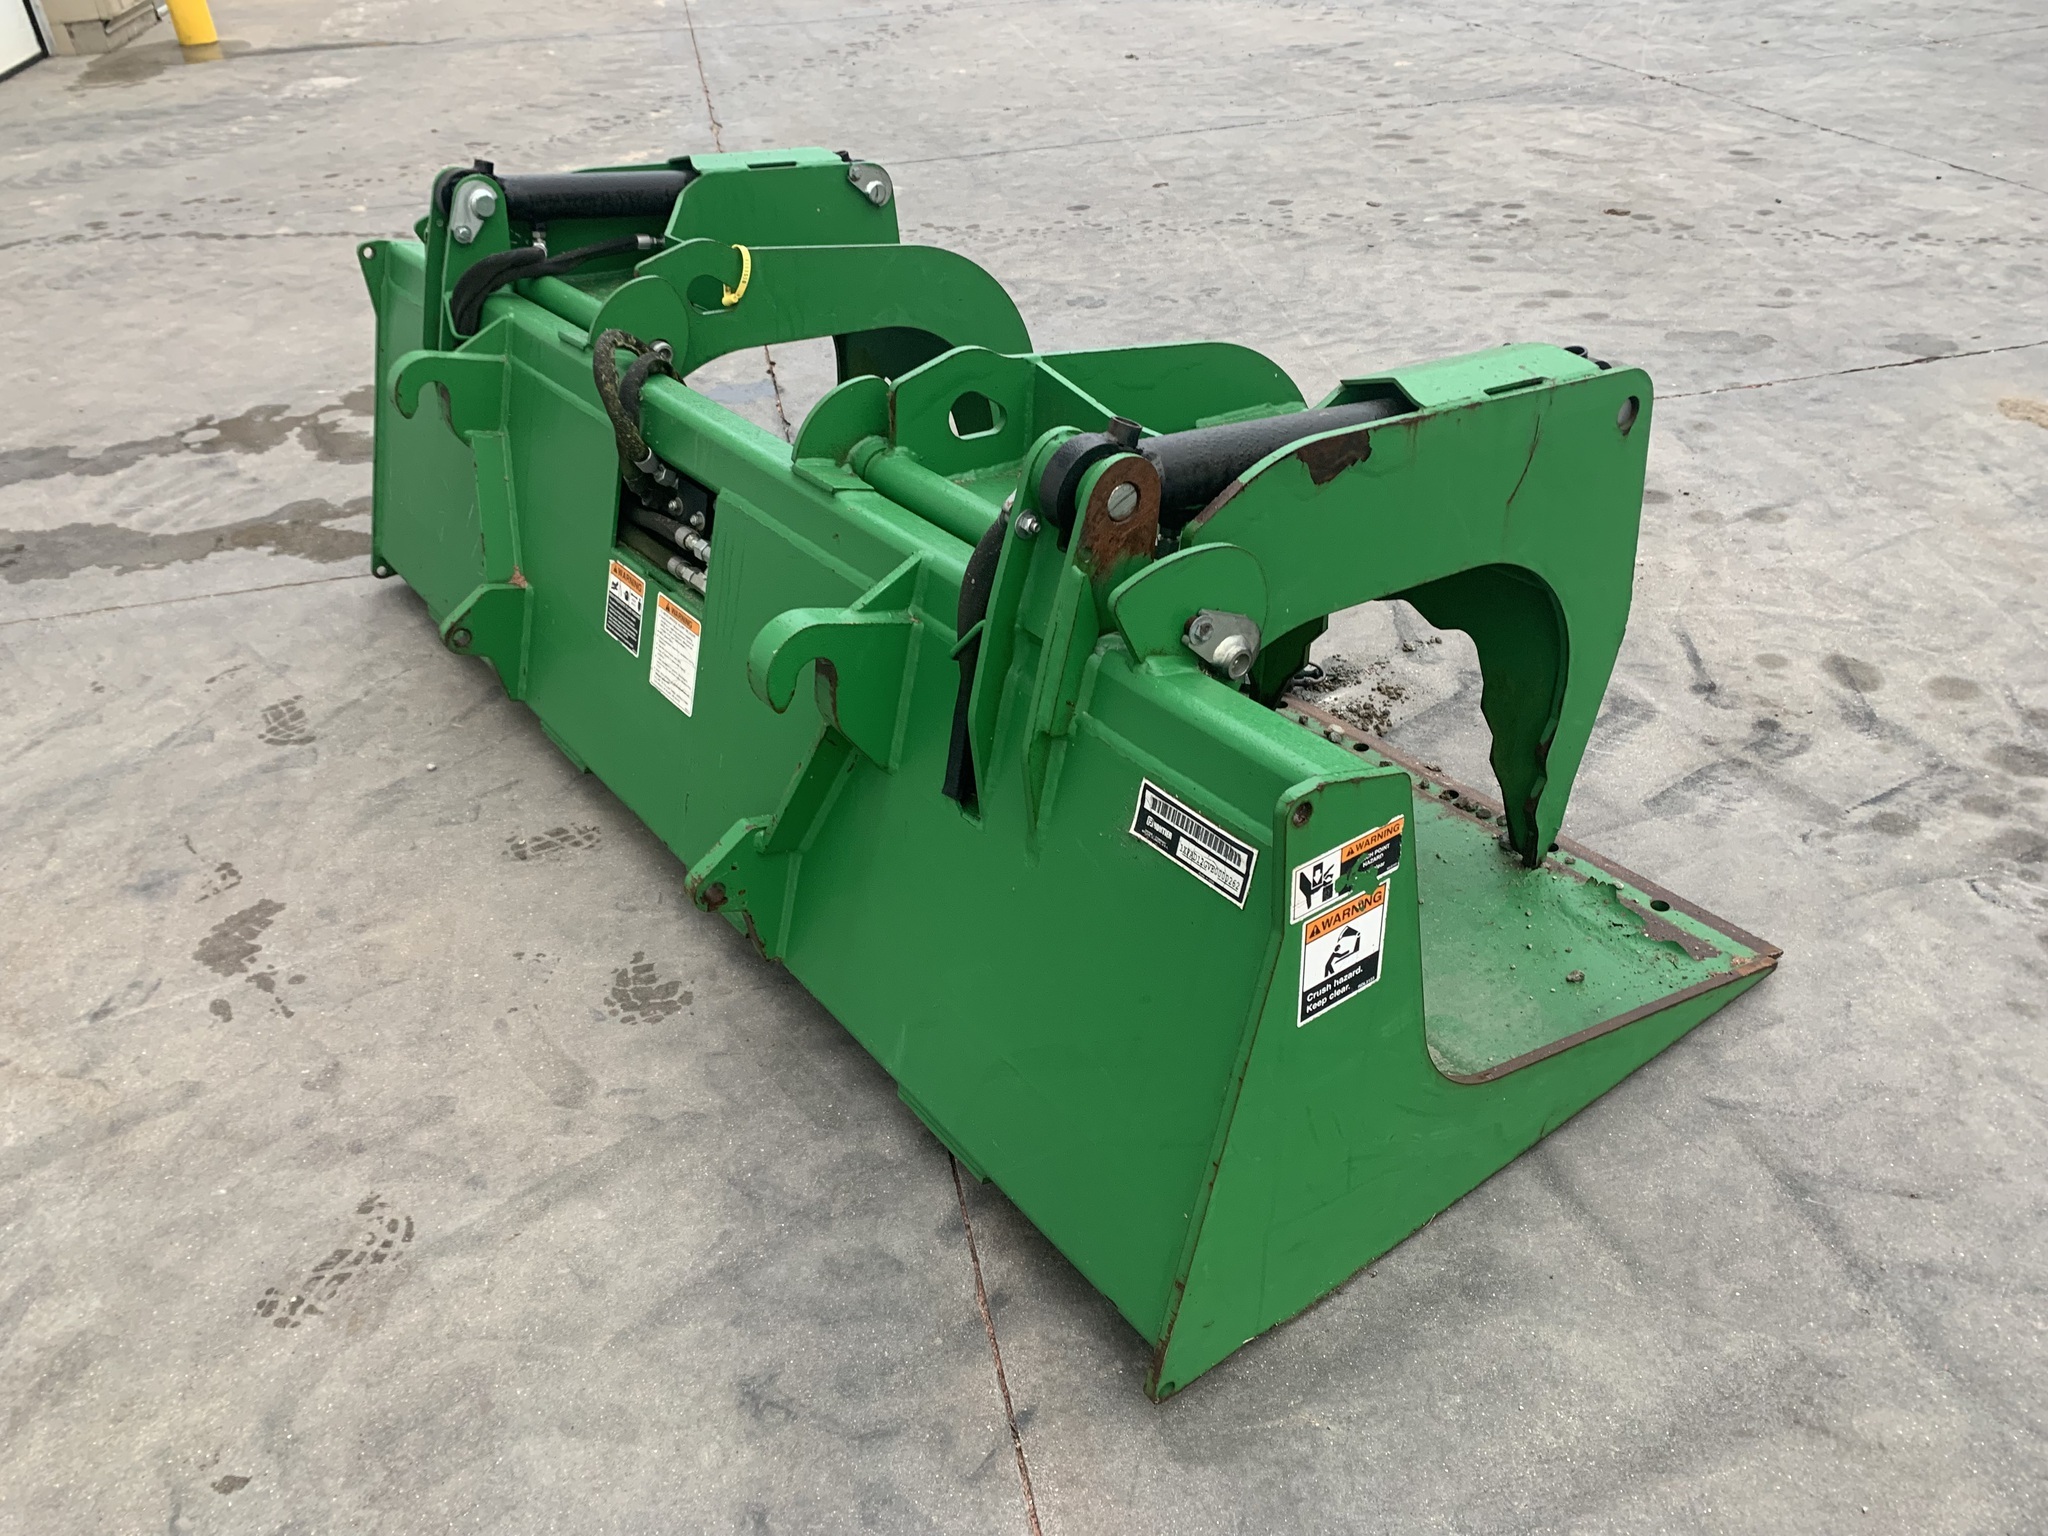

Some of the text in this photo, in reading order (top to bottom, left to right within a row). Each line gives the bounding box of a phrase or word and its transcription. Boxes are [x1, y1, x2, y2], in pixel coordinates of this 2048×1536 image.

[617, 566, 642, 593] WARNING
[671, 607, 693, 629] WARNING
[1356, 823, 1400, 852] WARNING
[1374, 842, 1391, 855] POINT
[1362, 852, 1384, 868] HAZARD
[1306, 984, 1331, 1002] Crush
[1333, 965, 1363, 988] hazard.
[1306, 983, 1351, 1014] Keep clear.
